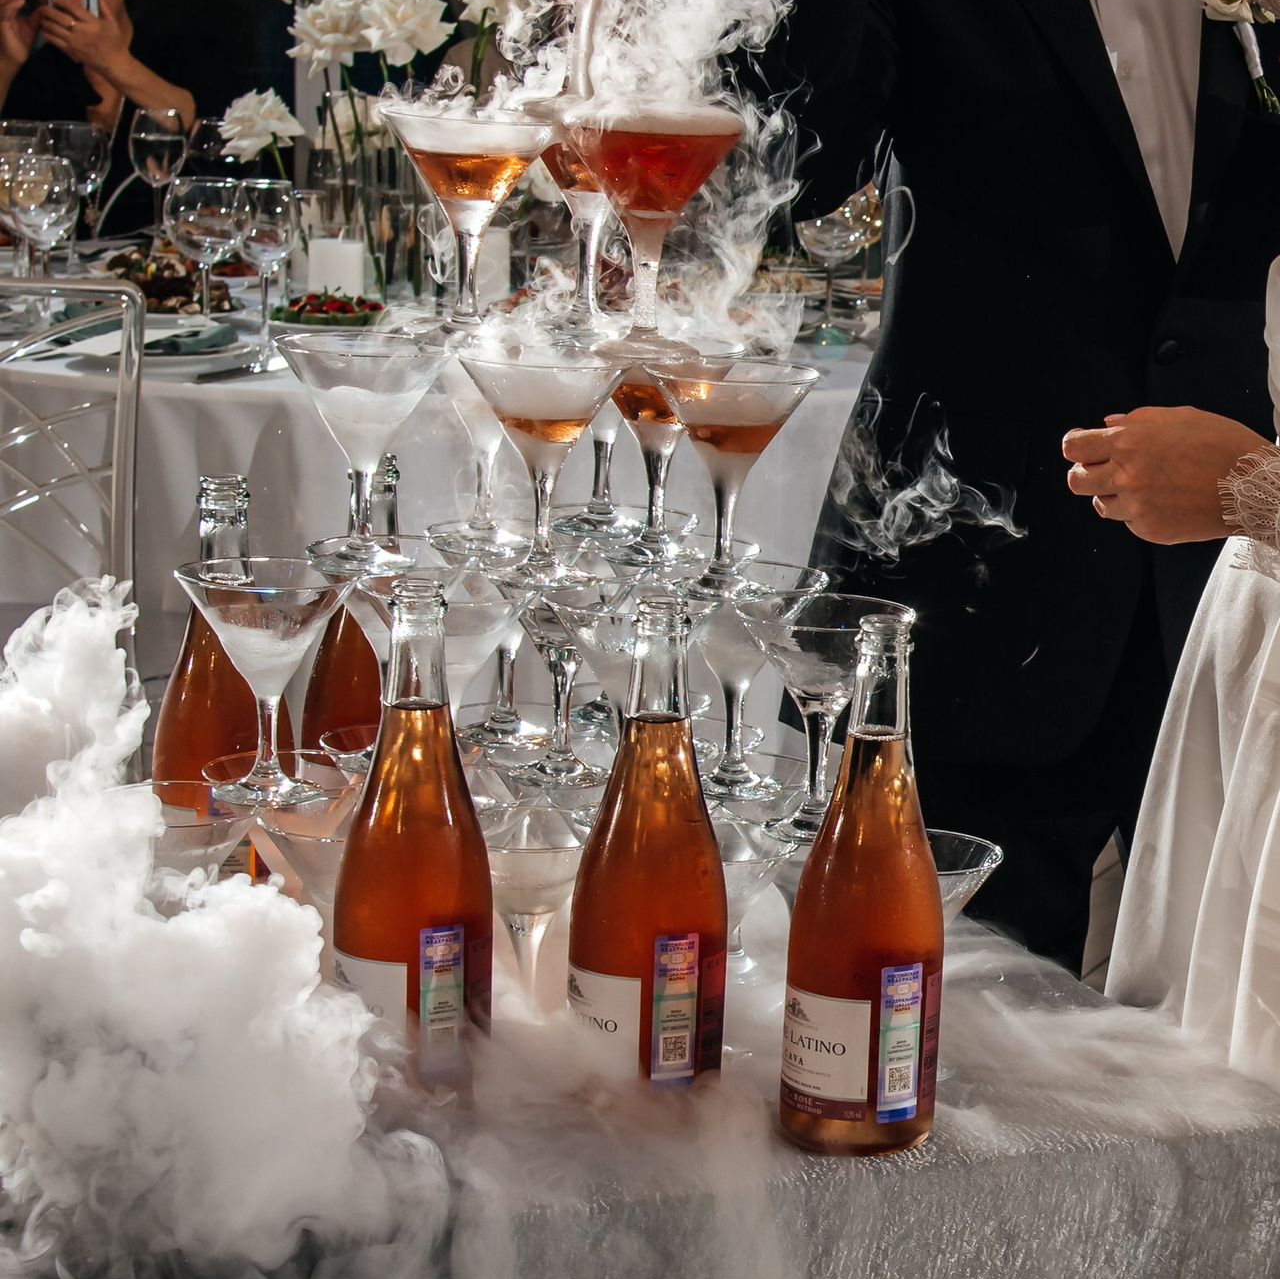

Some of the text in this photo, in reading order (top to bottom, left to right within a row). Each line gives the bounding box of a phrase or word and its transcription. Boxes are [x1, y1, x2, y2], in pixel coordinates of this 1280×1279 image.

[574, 1012, 618, 1033] ATINO
[790, 1030, 846, 1056] LATINO
[784, 1048, 804, 1066] CAVA
[794, 1093, 813, 1106] ROSÉ
[796, 1103, 822, 1114] METHOD
